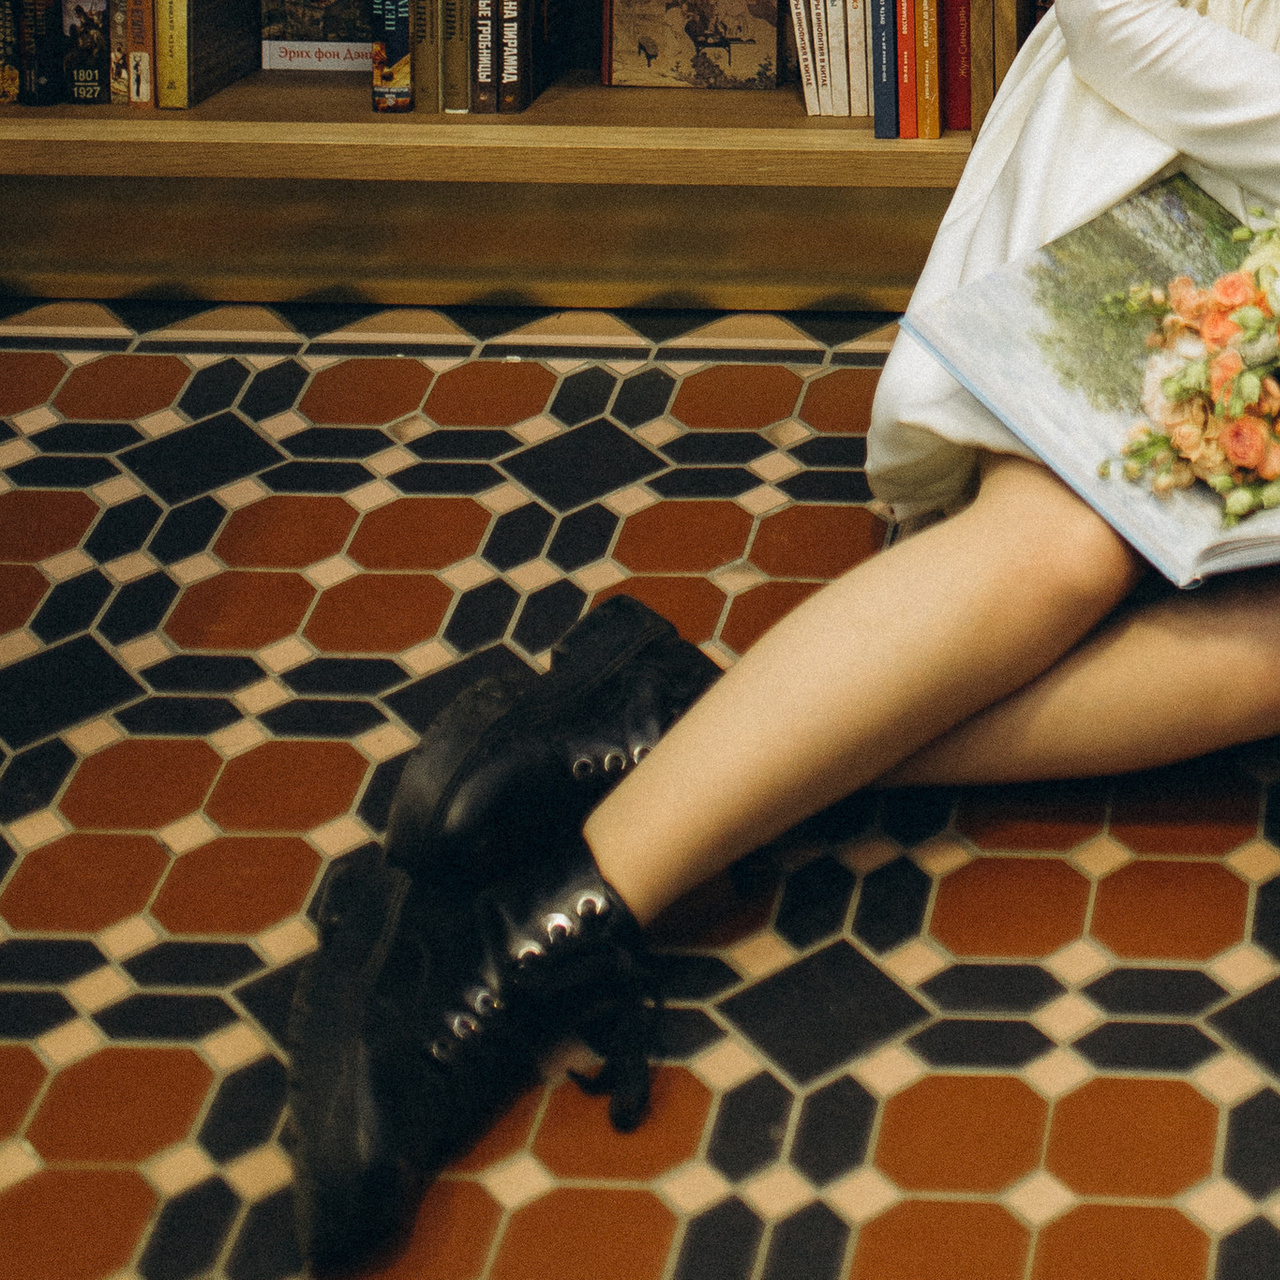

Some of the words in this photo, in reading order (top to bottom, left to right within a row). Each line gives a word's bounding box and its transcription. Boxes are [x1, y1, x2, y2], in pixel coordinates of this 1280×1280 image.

[477, 19, 492, 83] ГРОБНИЦЫ
[502, 22, 519, 84] ПИРАМИД
[73, 69, 99, 83] 1801
[73, 85, 101, 99] 1927
